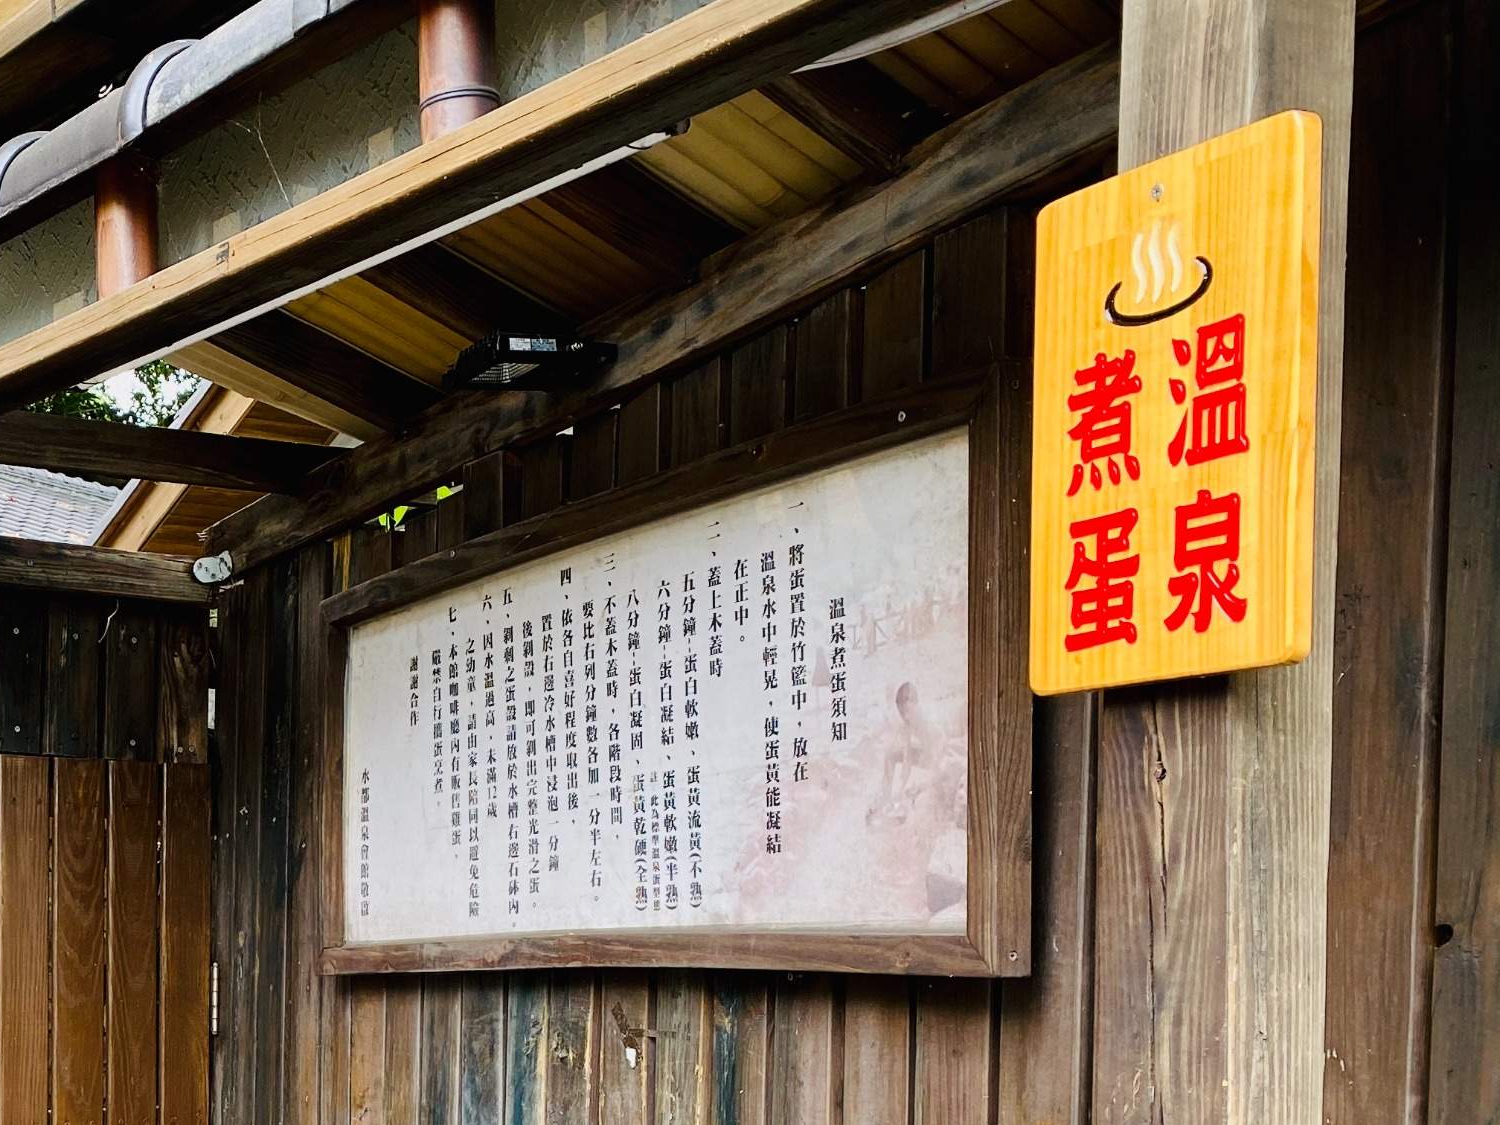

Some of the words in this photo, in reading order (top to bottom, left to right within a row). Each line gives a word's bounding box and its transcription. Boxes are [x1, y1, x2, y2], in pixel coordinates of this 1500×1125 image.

[1064, 348, 1142, 652] 煮蛋
[1164, 312, 1249, 634] 溫泉
[707, 521, 724, 678] 二、蓋上木蓋時
[733, 558, 749, 642] 在正中。
[828, 597, 847, 742] 溫泉煮蛋須知
[409, 656, 419, 727] 謝謝合作
